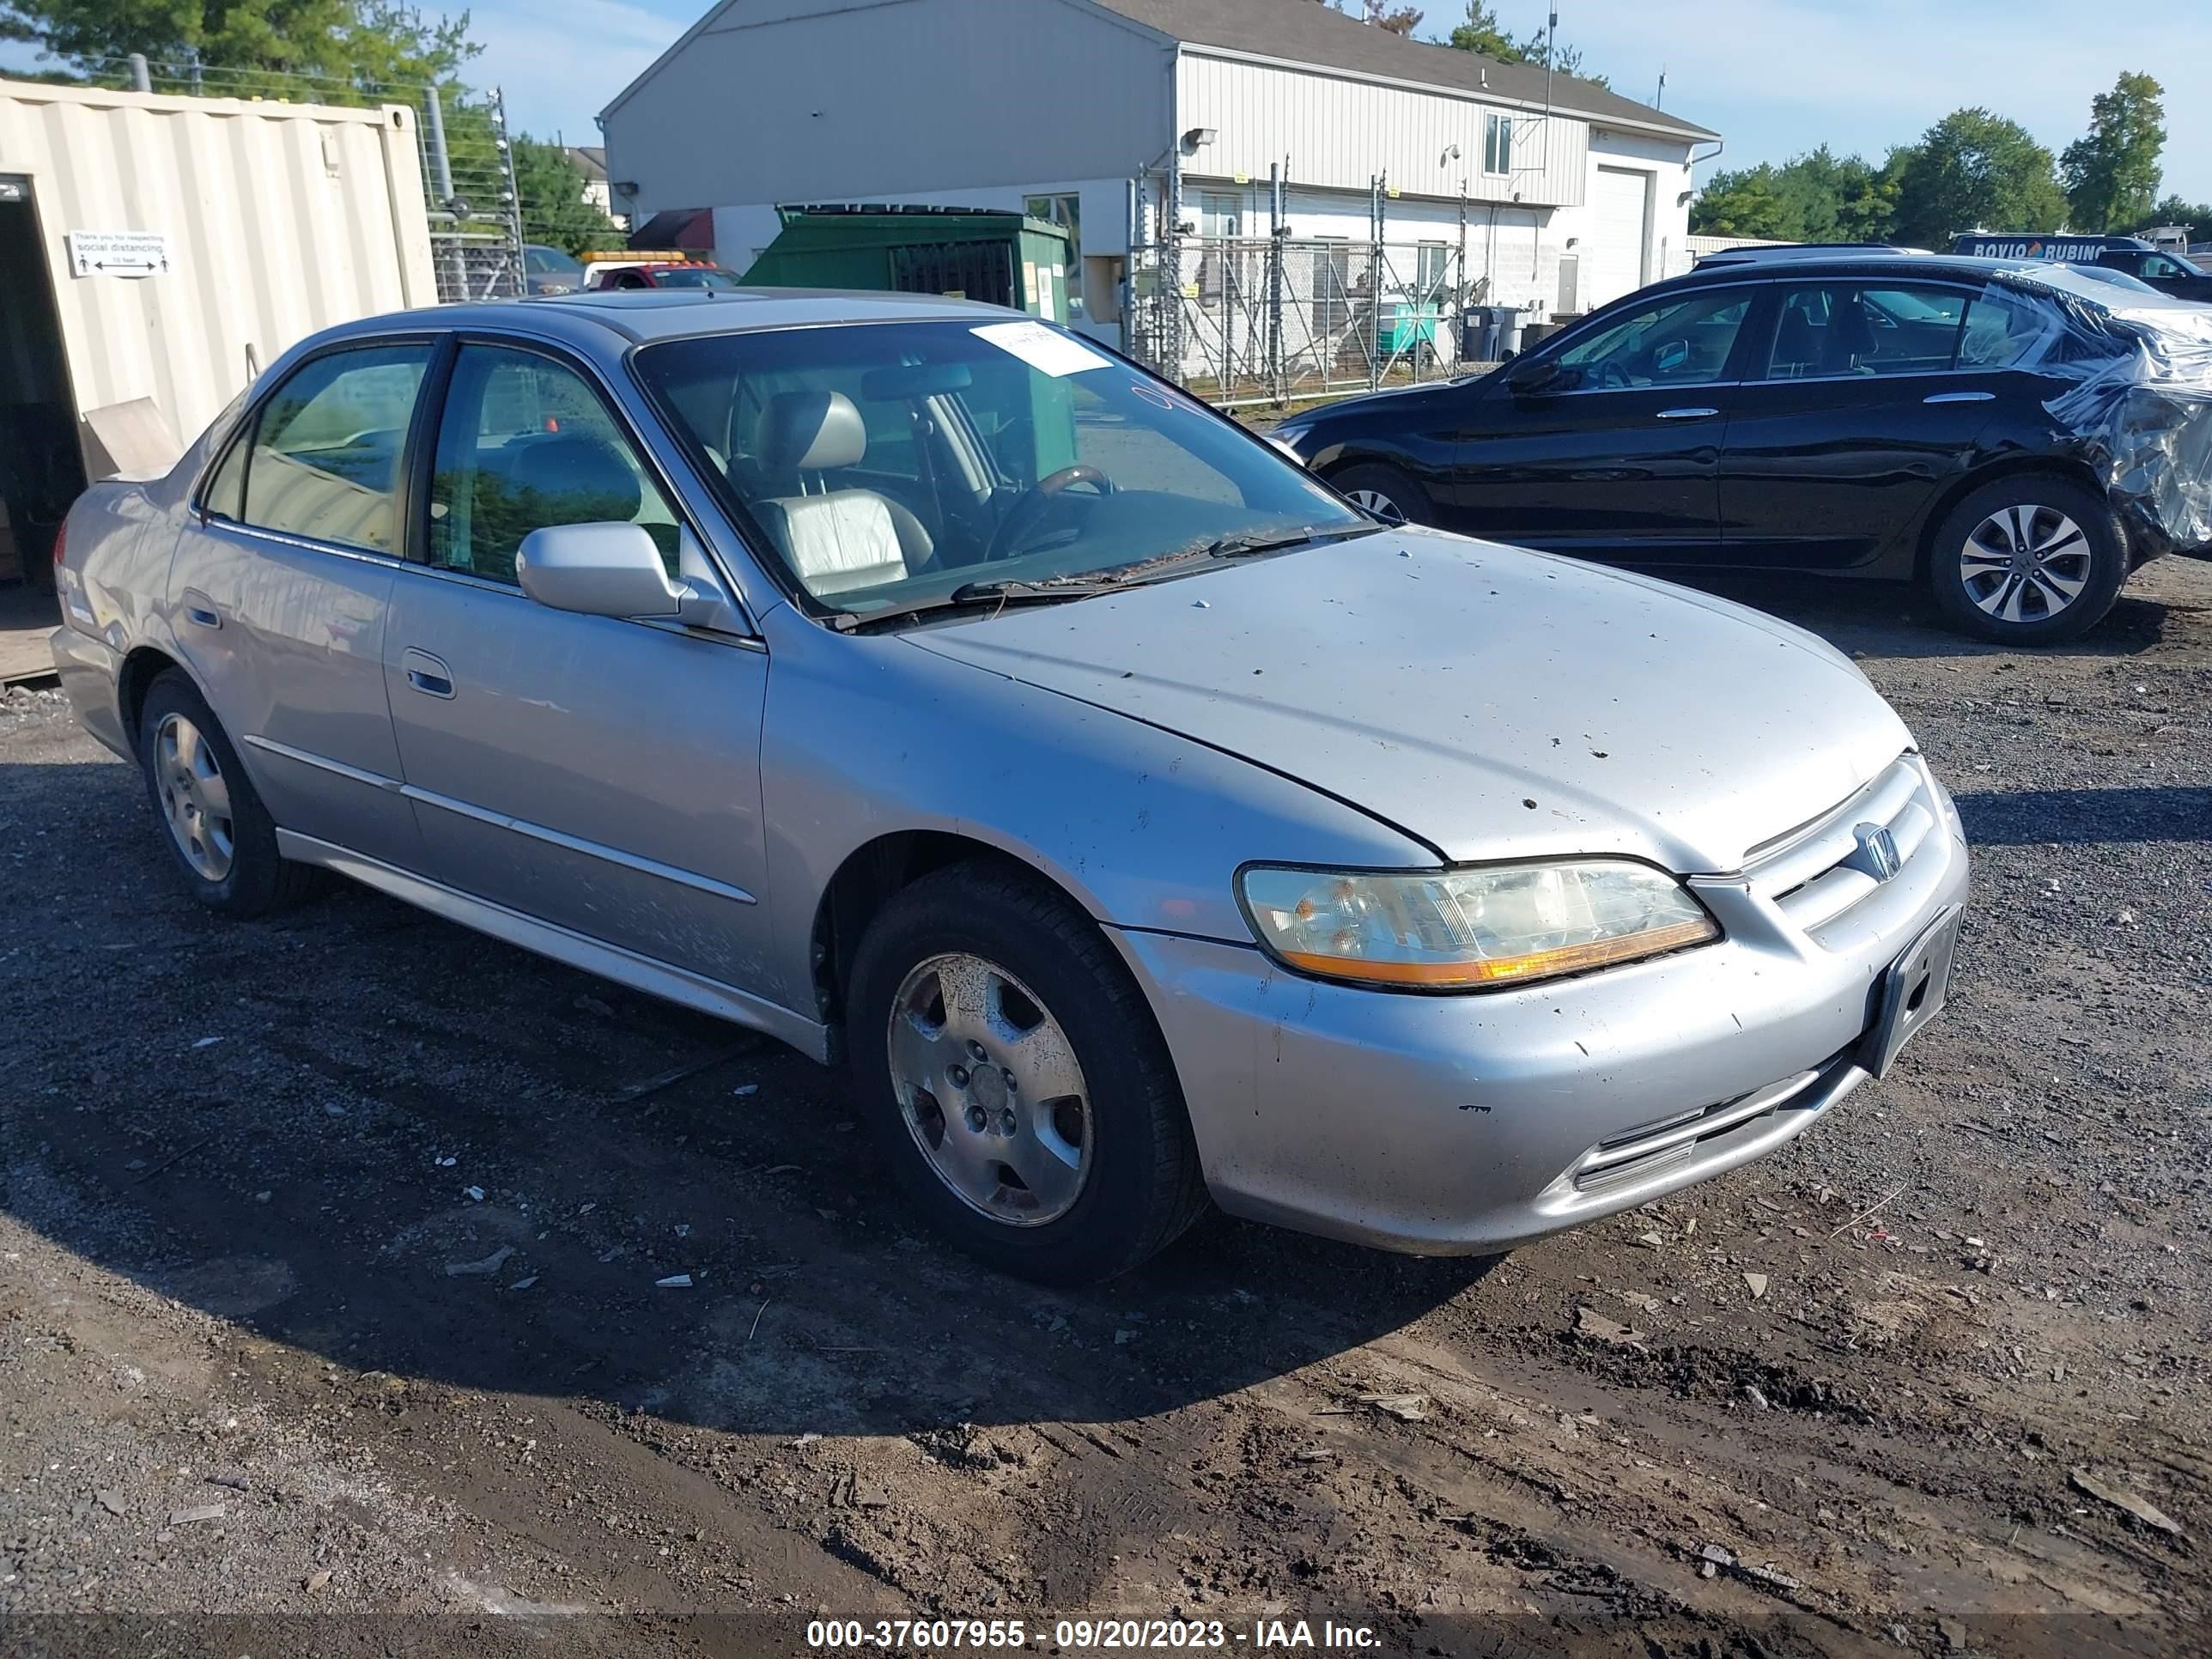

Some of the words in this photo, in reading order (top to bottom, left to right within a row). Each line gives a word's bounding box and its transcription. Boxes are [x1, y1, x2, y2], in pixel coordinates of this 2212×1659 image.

[126, 235, 164, 244] respecting
[77, 241, 107, 252] social
[110, 242, 163, 254] distancing
